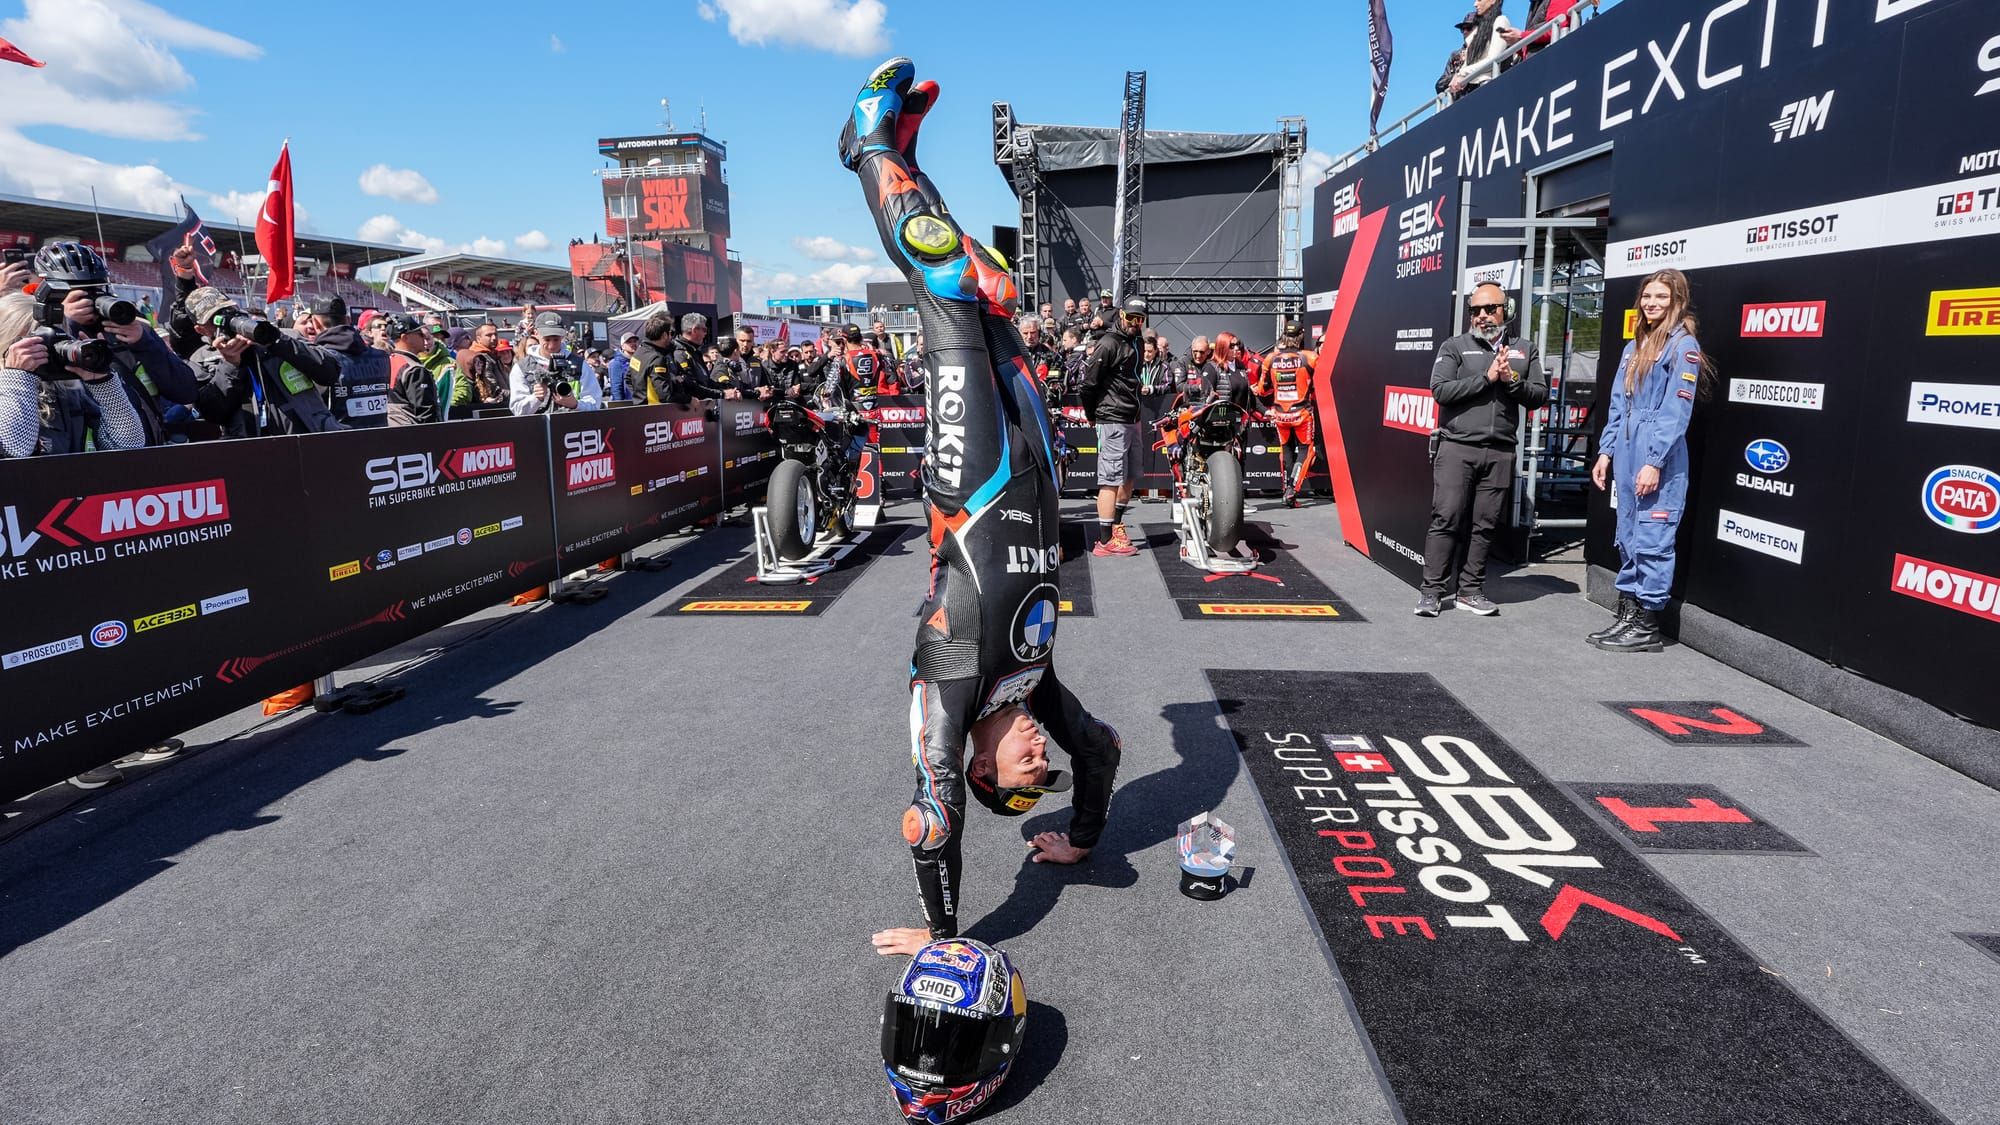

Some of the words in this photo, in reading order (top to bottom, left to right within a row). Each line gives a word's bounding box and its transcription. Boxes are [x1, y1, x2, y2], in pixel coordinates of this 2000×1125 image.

[1457, 80, 1577, 178] MAKE
[1769, 89, 1835, 143] FIM
[617, 140, 658, 149] AUTODROM
[658, 138, 679, 147] MOST
[641, 178, 688, 196] WORLD
[1333, 178, 1363, 215] SBK
[643, 194, 690, 230] SBK
[1334, 211, 1360, 238] MOTUL
[1398, 195, 1446, 241] SBK
[1934, 217, 1964, 228] SWISS
[1771, 213, 1839, 240] TISSOT
[1409, 231, 1444, 257] TISSOT
[1643, 239, 1687, 259] TISSOT
[1396, 253, 1443, 280] SUPERPOLE
[1482, 269, 1504, 280] TISSOT
[1743, 306, 1820, 333] MOTUL
[1937, 296, 2000, 327] PIRE
[1749, 384, 1800, 404] PROSECCO
[1802, 386, 1818, 400] DOC
[1385, 391, 1435, 429] MOTUL
[564, 428, 614, 459] SBK
[644, 421, 678, 446] SBK
[681, 419, 704, 437] MOTUL
[366, 450, 448, 494] SBK
[462, 446, 513, 473] MOTUL
[569, 457, 614, 486] MOTUL
[1951, 467, 1985, 481] SNACK
[368, 495, 387, 508] FIM
[389, 485, 436, 505] SUPERBIKE
[438, 479, 465, 495] WORLD
[467, 471, 517, 489] CHAMPIONSHIP
[1736, 472, 1795, 497] SUBARU
[100, 486, 223, 534] MOTUL
[1940, 485, 1988, 512] PATA
[36, 547, 107, 573] WORLD
[114, 523, 233, 558] CHAMPIONSHIP
[565, 544, 575, 553] WE
[575, 537, 591, 550] MAKE
[592, 526, 623, 544] EXCITEMENT
[1723, 519, 1798, 553] PROMETEON
[1006, 543, 1058, 574] OKiT
[204, 595, 248, 611] PROMETEON
[411, 598, 425, 609] WE
[429, 587, 453, 604] MAKE
[455, 570, 504, 594] EXCITEMENT
[136, 607, 196, 630] ACERBIS
[98, 628, 120, 640] PATA
[22, 642, 67, 662] PROSECCO
[67, 638, 79, 648] DOC
[14, 720, 79, 754] MAKE
[86, 675, 204, 728] EXCITEMENT
[1627, 708, 1764, 735] 2
[1595, 797, 1753, 832] 1
[1264, 732, 1436, 940] SUPERPOLE
[1382, 734, 1665, 928] SBK
[1355, 776, 1530, 941] TISSOT
[938, 859, 954, 916] DAINESE
[918, 979, 957, 999] SHOEI
[894, 995, 915, 1006] GIVES
[920, 999, 942, 1010] YOU
[946, 1004, 984, 1020] WINGS
[898, 1064, 944, 1083] PROMETEON
[946, 1088, 986, 1120] Red
